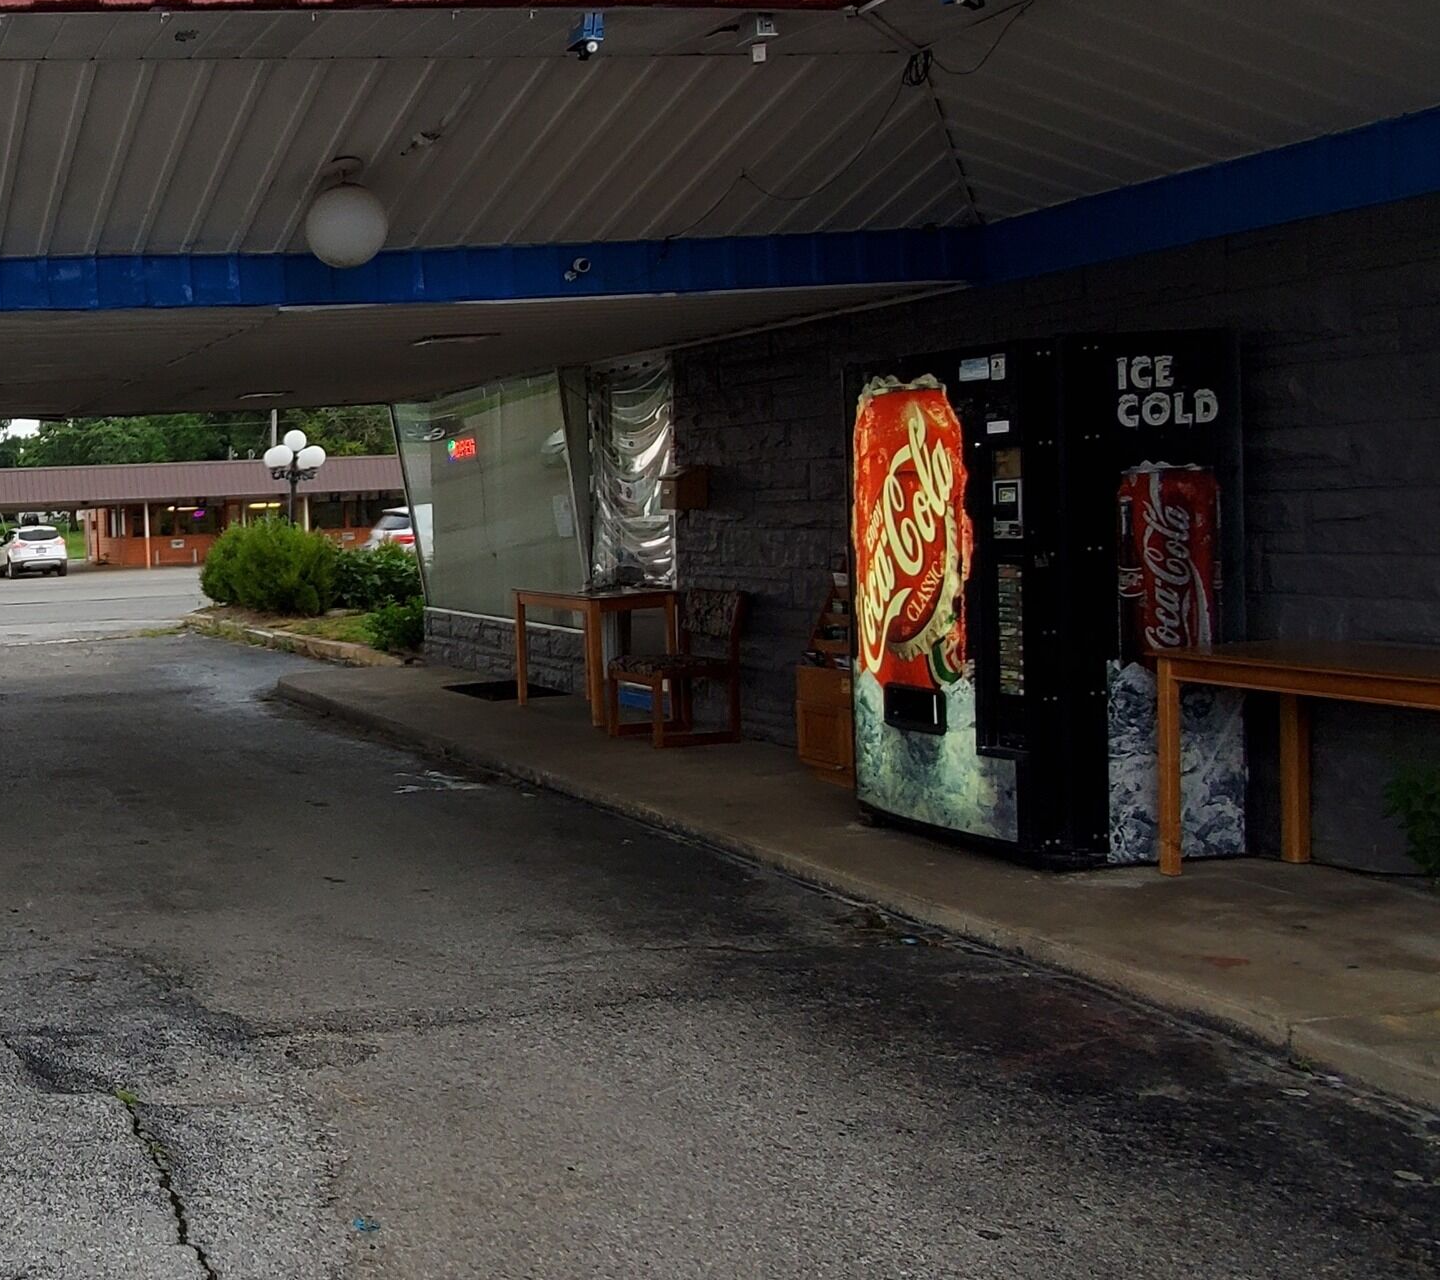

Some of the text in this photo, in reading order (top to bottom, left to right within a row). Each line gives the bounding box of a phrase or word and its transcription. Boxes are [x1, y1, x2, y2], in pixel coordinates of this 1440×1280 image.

[1116, 355, 1174, 390] ICE
[1117, 388, 1219, 428] COLD
[452, 438, 476, 459] OPEN
[862, 404, 954, 674] Coca-Cola
[906, 562, 947, 622] CLASSIC
